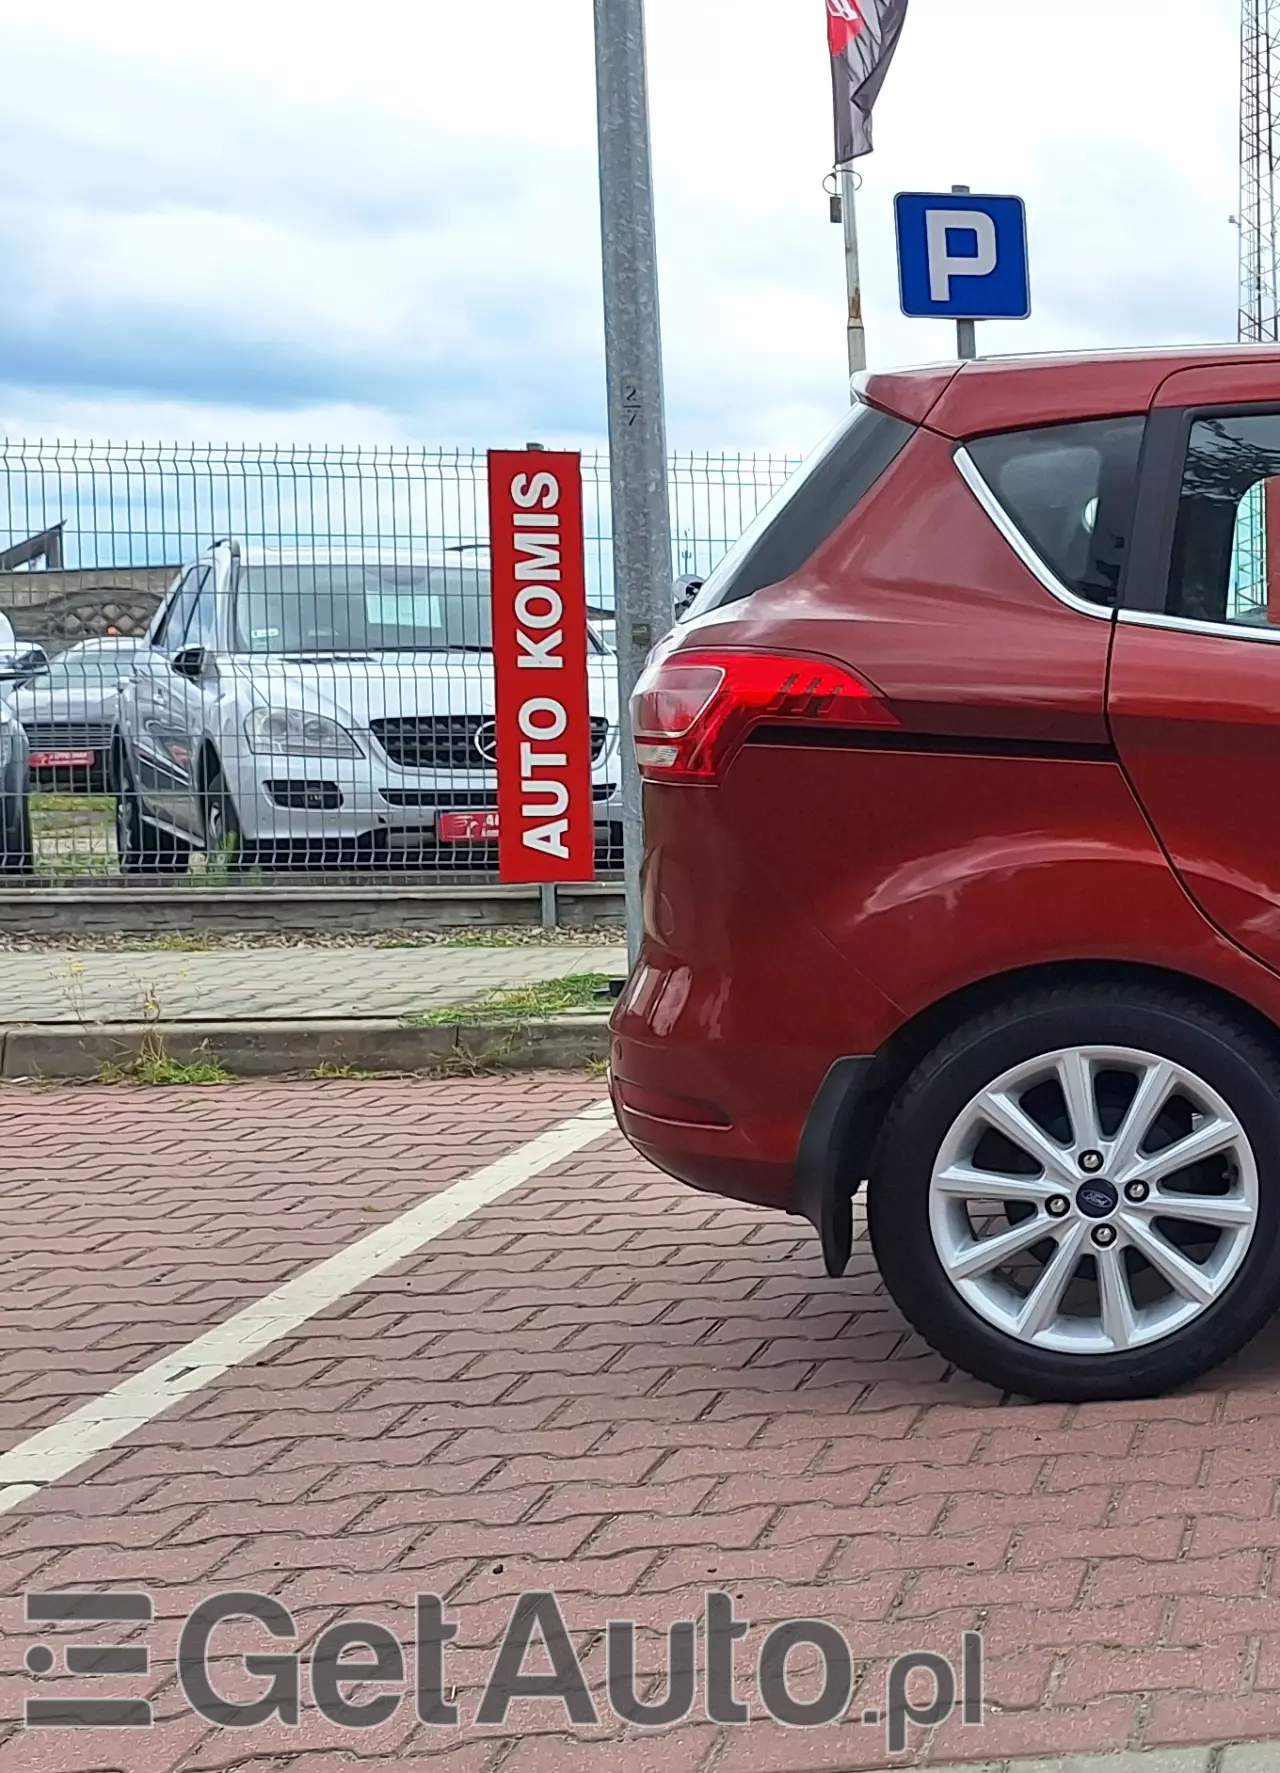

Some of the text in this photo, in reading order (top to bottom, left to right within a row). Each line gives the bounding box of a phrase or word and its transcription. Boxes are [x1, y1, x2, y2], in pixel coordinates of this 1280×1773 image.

[925, 209, 997, 302] P
[510, 471, 570, 860] AUTO KOMIS
